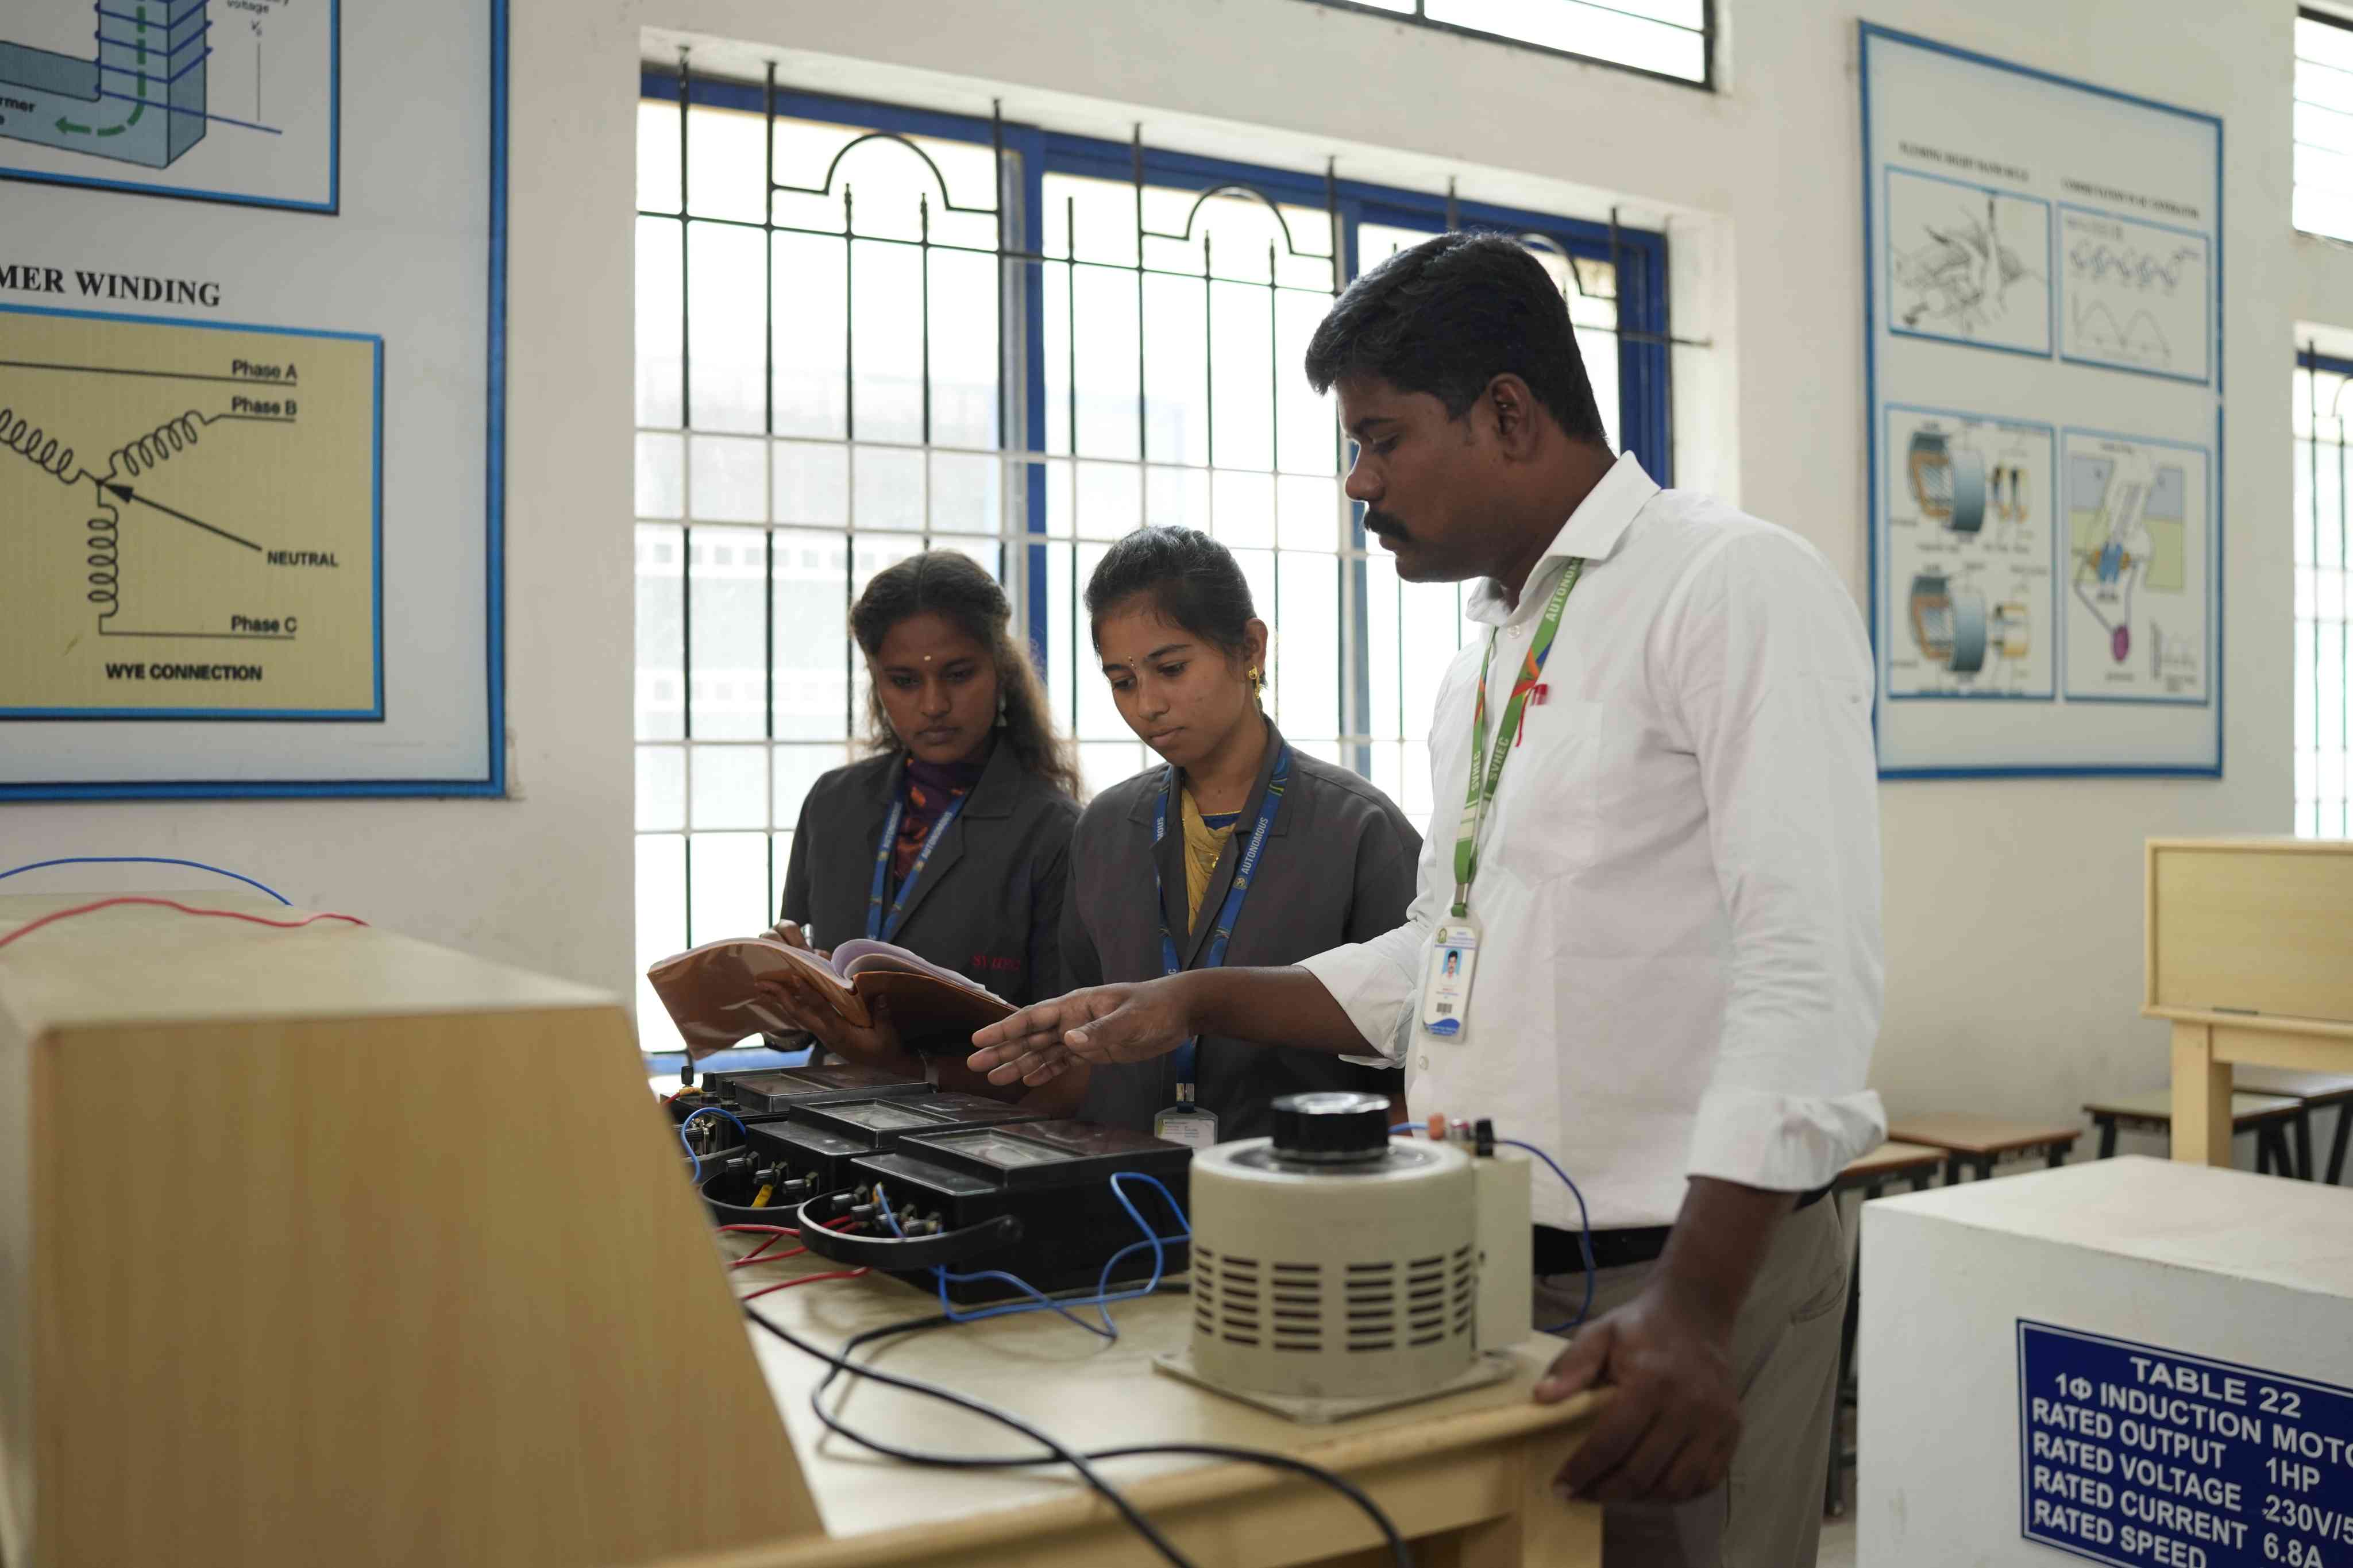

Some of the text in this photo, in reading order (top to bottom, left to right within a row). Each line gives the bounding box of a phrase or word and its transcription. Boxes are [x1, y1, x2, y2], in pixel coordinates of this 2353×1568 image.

[75, 270, 221, 307] WINDING
[232, 358, 297, 379] Phase A
[232, 396, 297, 415] Phase B
[267, 551, 338, 567] NEUTRAL
[232, 615, 297, 632] Phase C
[106, 663, 263, 681] WYE CONNECTION
[1488, 737, 1510, 781] SVHEC
[1241, 817, 1268, 874] AUTONOMOUS
[2129, 1356, 2301, 1419] TABLE 22
[2100, 1381, 2262, 1445] INDUCTION
[2032, 1397, 2320, 1493] RATED OUTPUT 1HP
[2033, 1431, 2114, 1474] RATED
[2119, 1453, 2242, 1512] VOLTAGE
[2034, 1465, 2324, 1568] RATED CURRENT 6.8A
[2034, 1498, 2207, 1568] RATED SPEED
